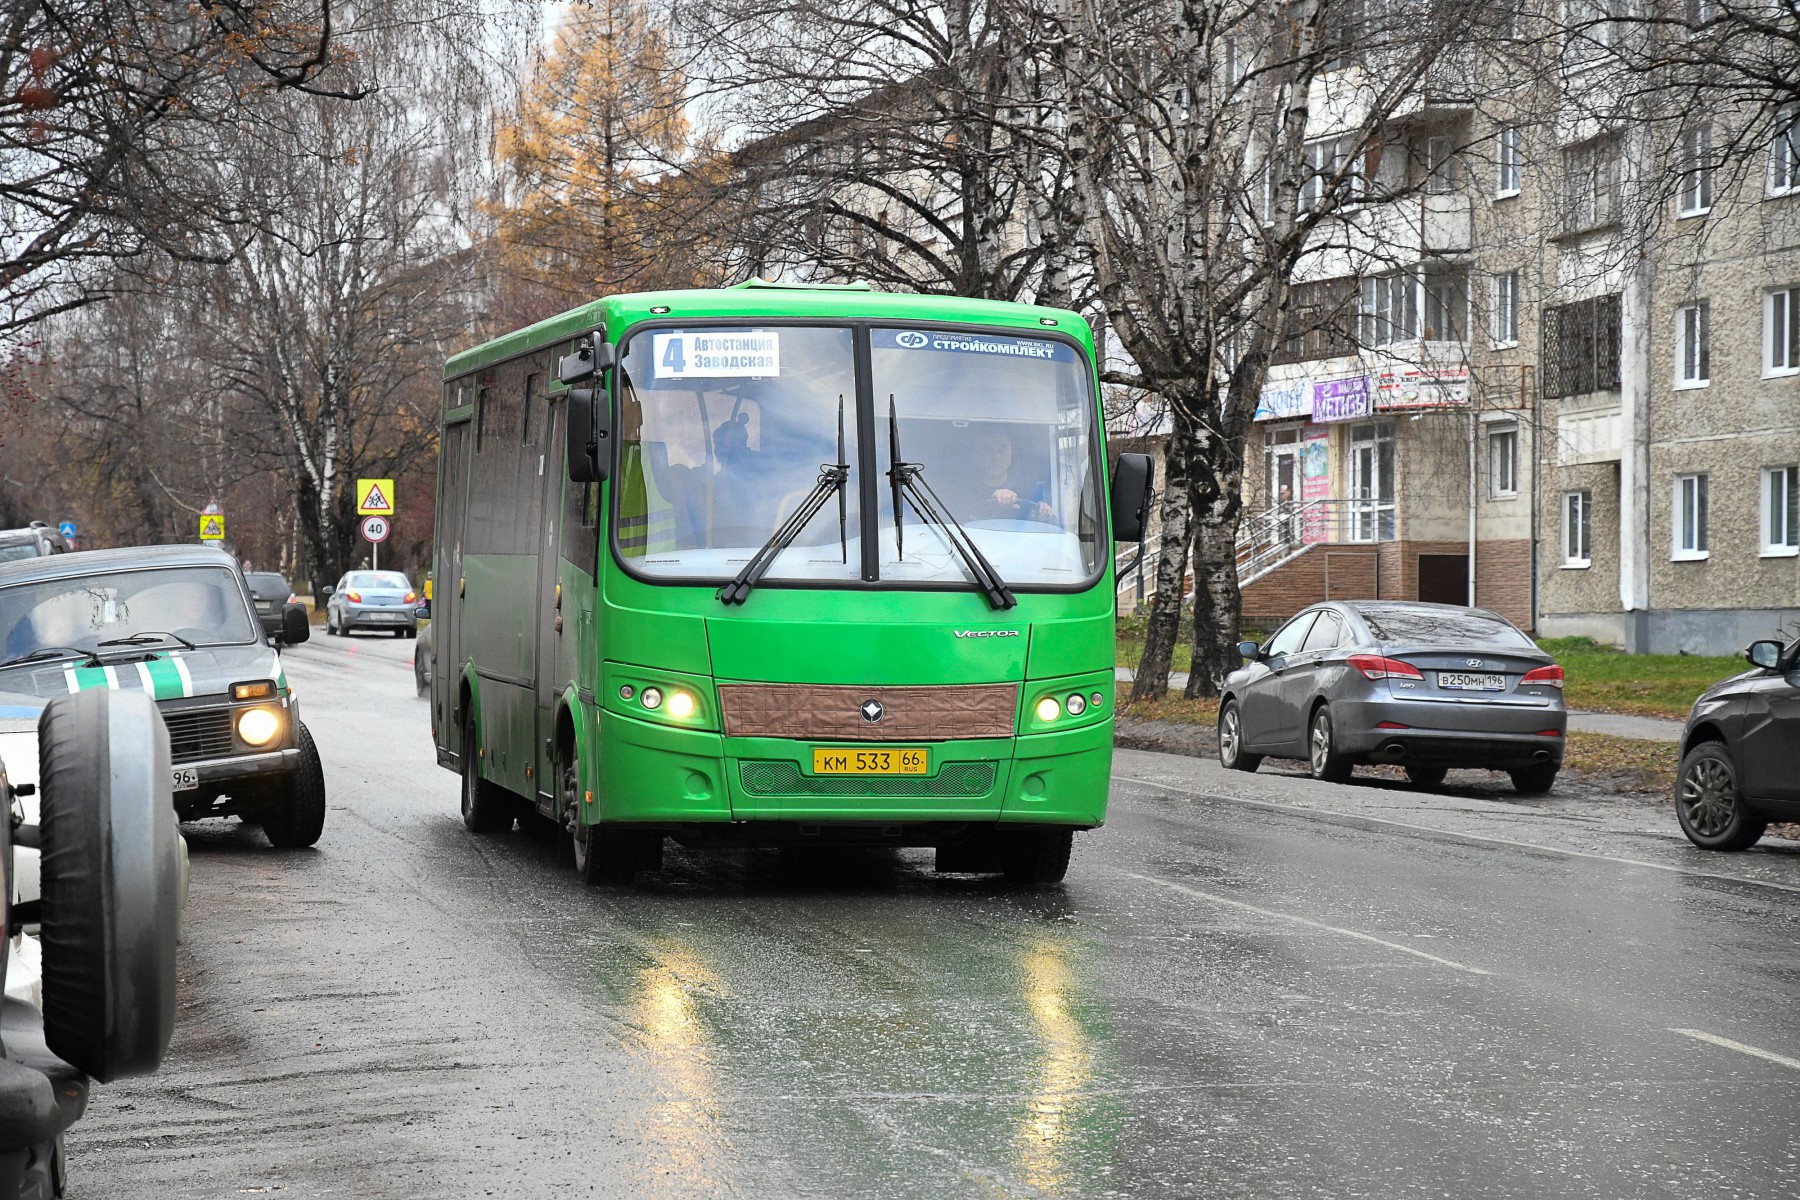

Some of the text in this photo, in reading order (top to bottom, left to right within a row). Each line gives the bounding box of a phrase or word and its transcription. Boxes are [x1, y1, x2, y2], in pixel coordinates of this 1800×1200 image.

[694, 337, 773, 352] Автостанция
[933, 340, 1055, 358] СТРОЙКОМПЛЕКТ
[662, 338, 686, 372] 4
[694, 354, 773, 369] Заводская
[368, 524, 382, 534] 40
[1487, 675, 1503, 685] 196
[824, 752, 920, 770] КМ 533 66
[173, 771, 191, 784] 96
